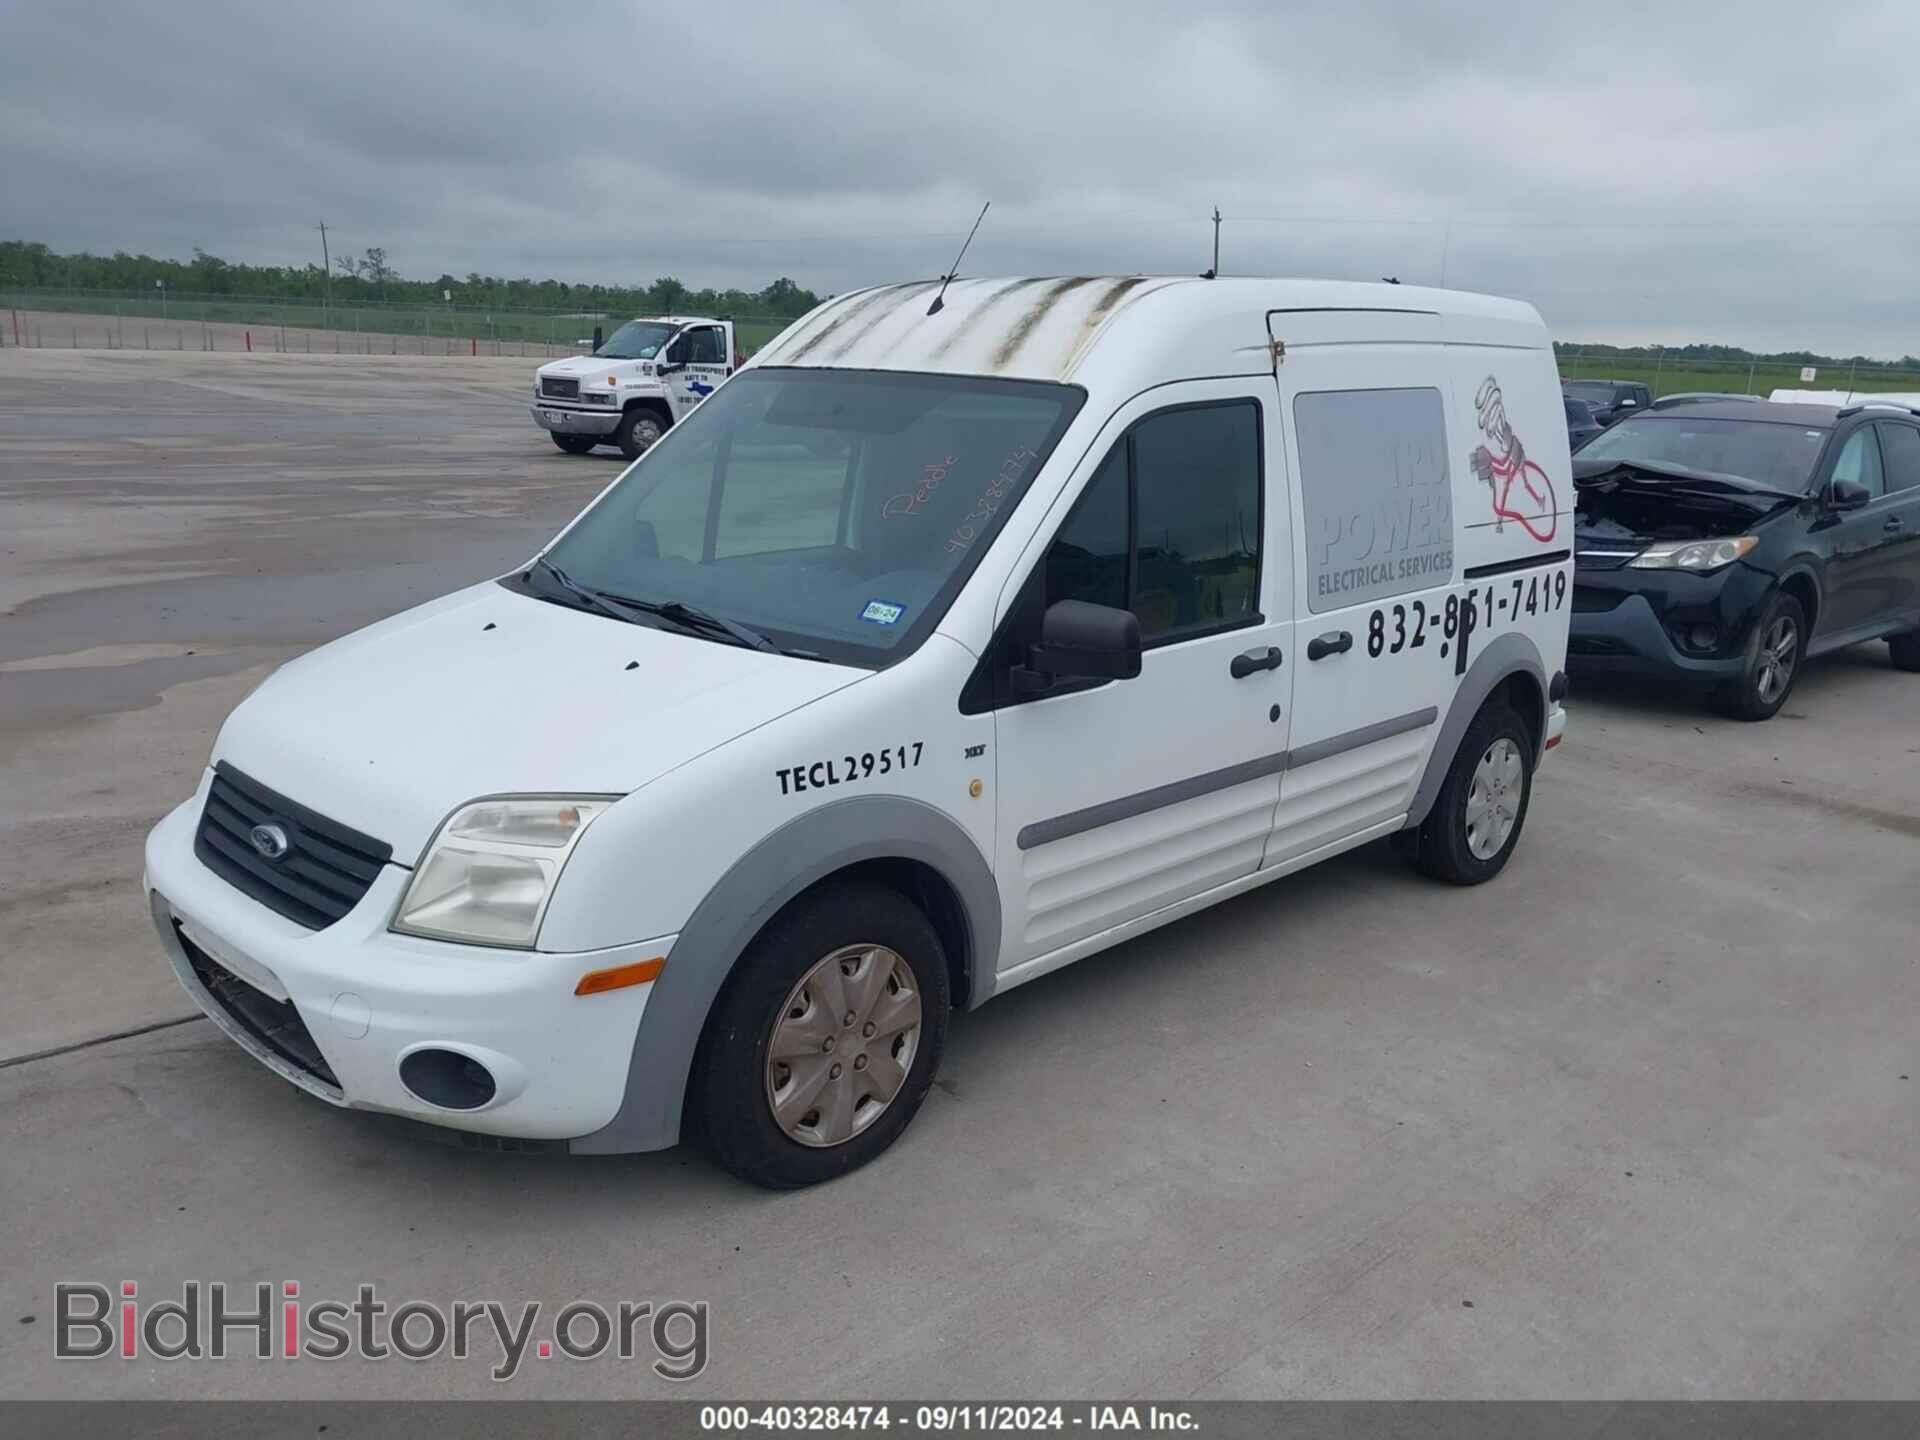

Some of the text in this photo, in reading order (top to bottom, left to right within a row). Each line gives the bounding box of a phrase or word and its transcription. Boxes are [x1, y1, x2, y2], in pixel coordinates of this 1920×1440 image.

[1319, 494, 1452, 566] POWER
[1318, 551, 1453, 596] ELECTRICAL SERVICES
[1367, 570, 1566, 658] 832-851-7419
[776, 742, 924, 795] TECL 29517
